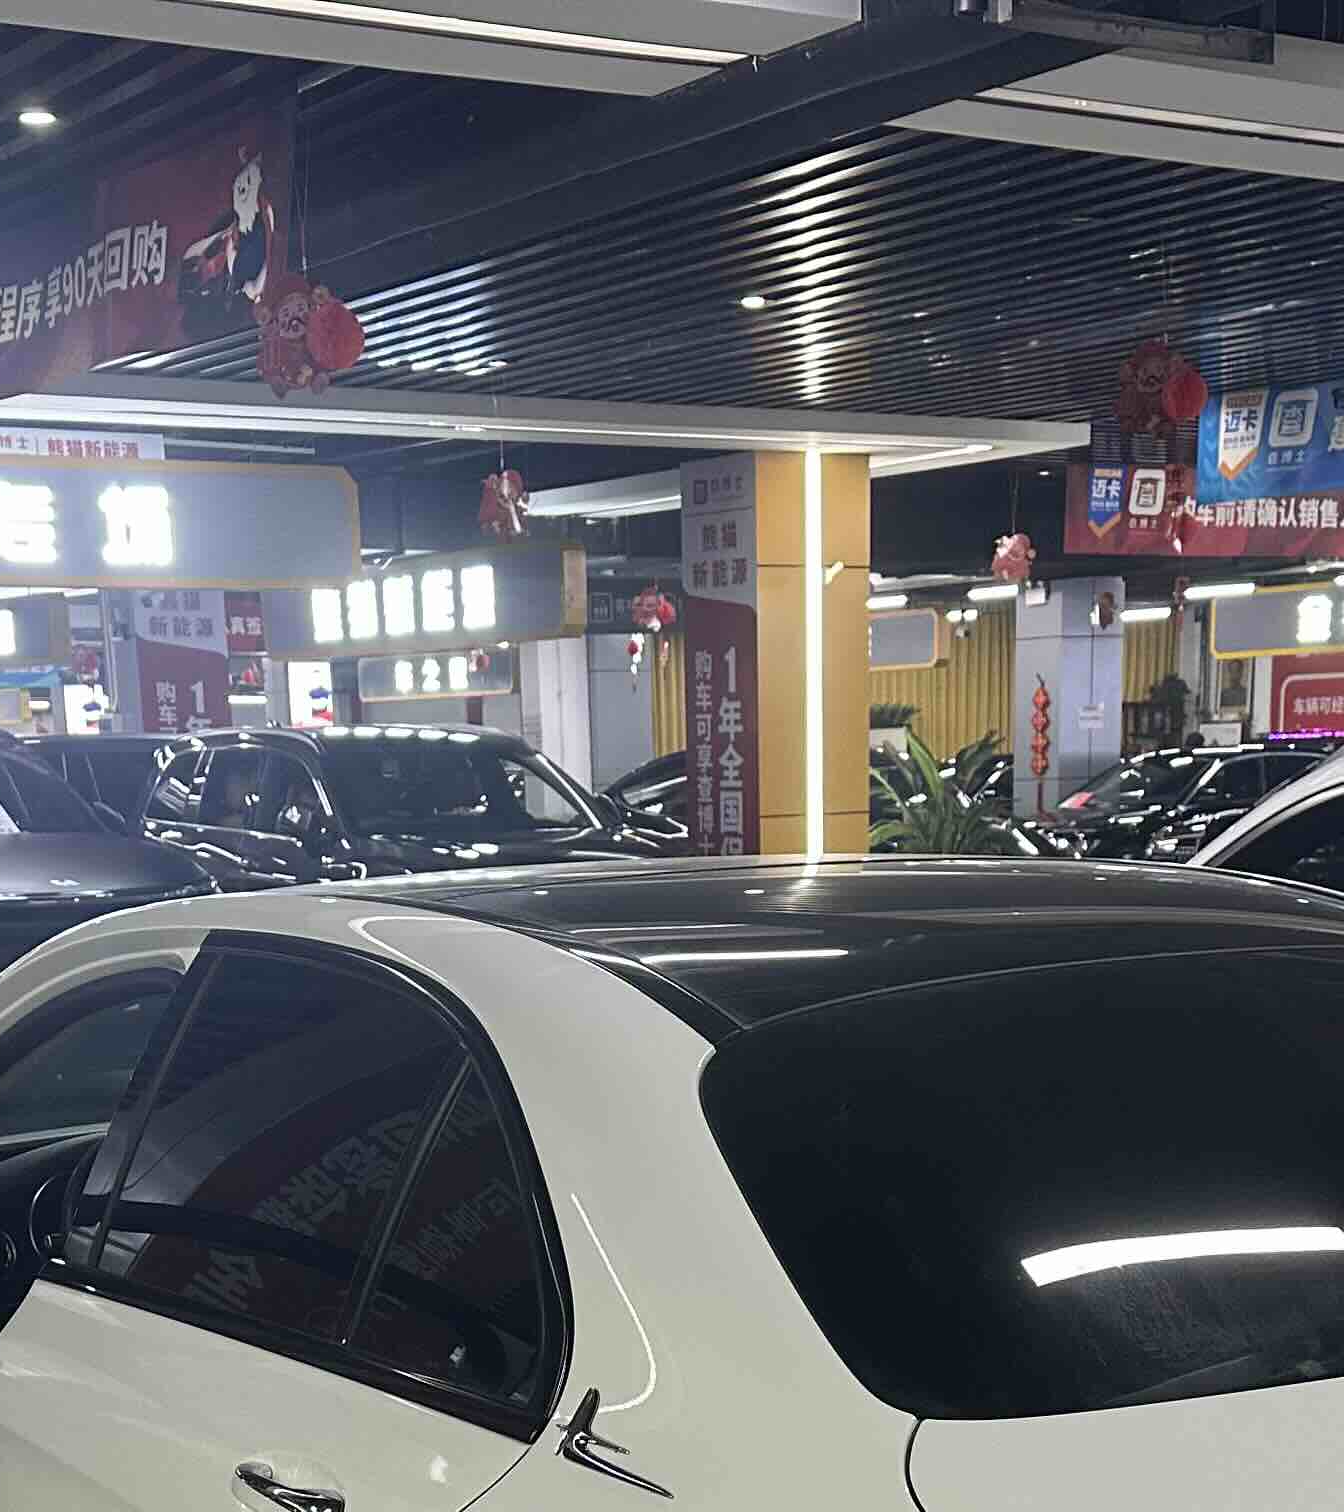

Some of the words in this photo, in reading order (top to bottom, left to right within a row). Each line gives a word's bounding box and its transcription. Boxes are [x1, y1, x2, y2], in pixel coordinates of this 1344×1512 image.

[1224, 408, 1258, 433] 迈卡
[1092, 479, 1121, 499] 迈卡
[155, 680, 177, 733] 购车
